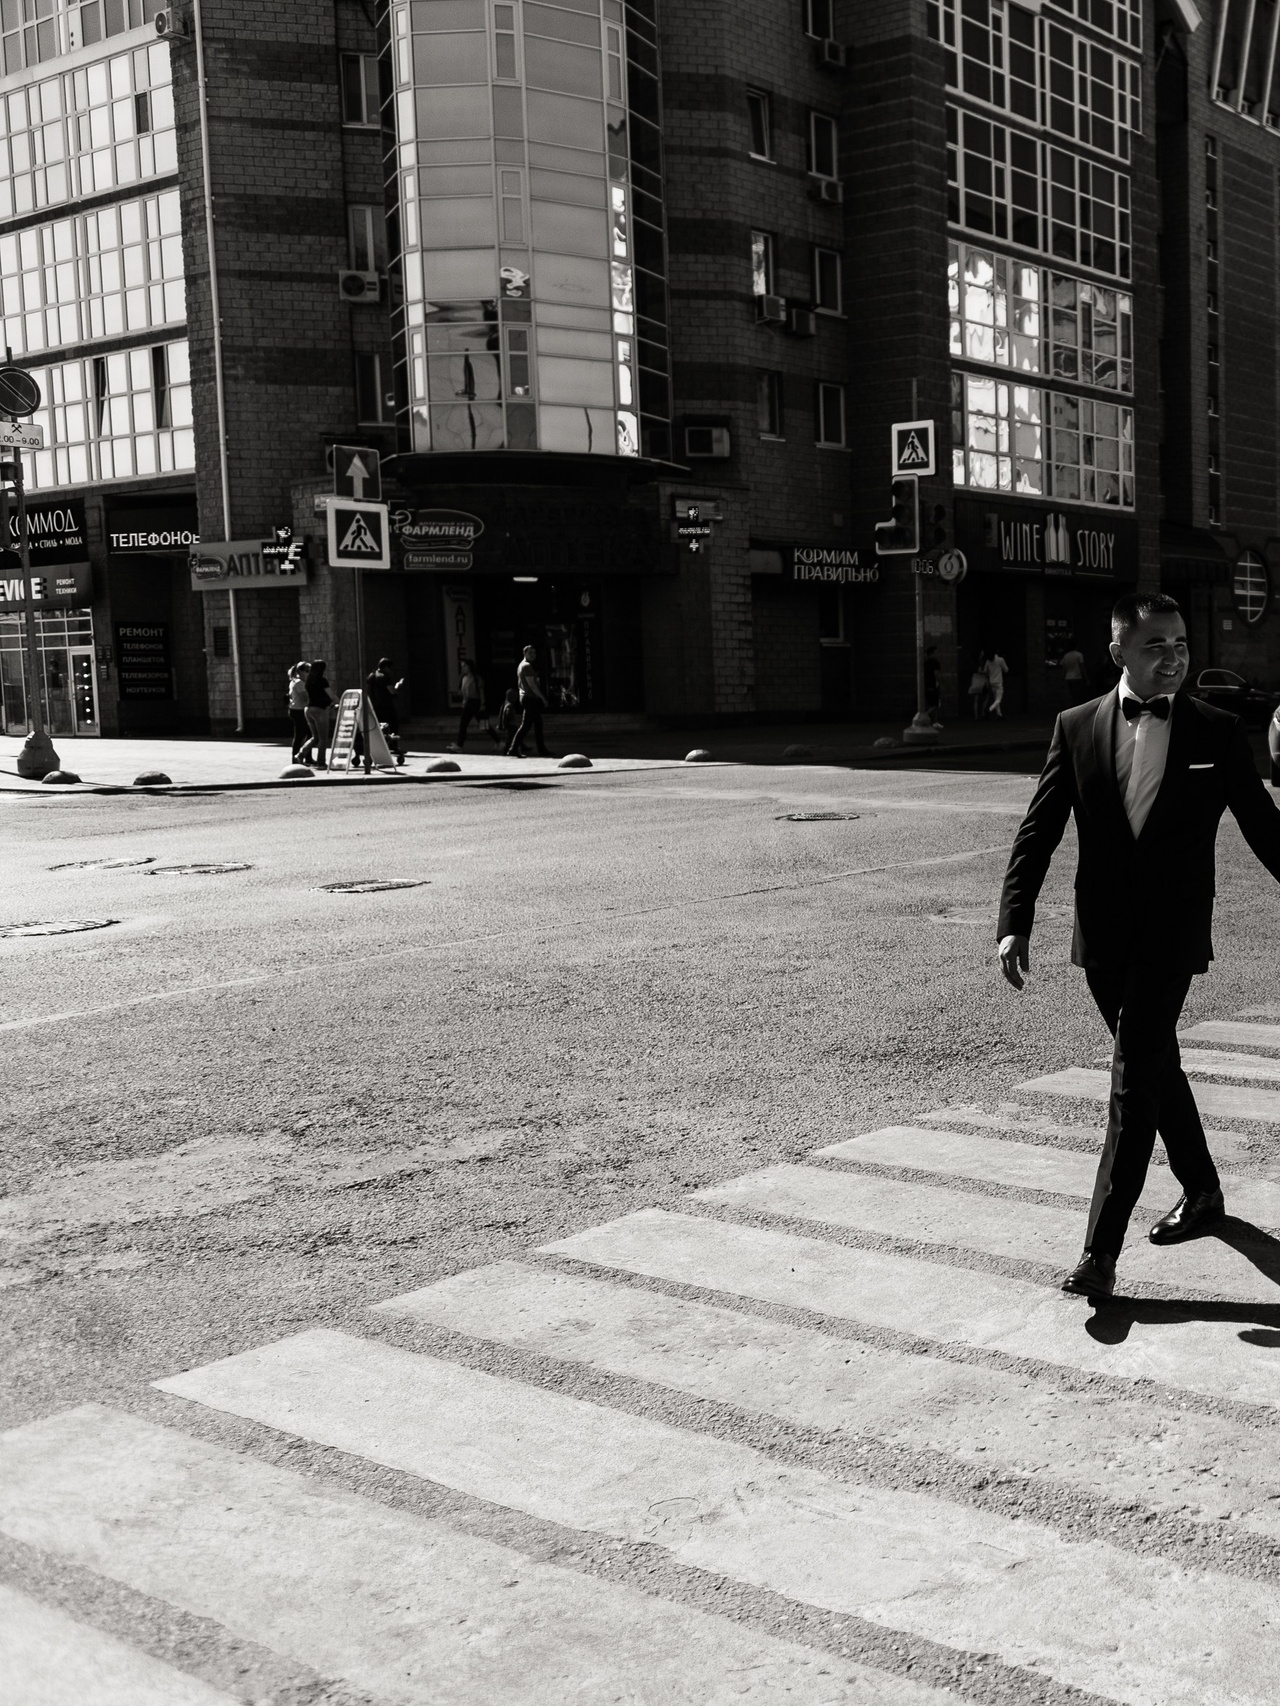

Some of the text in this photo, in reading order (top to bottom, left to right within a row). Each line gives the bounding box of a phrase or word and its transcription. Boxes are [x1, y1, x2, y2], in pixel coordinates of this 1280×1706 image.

[402, 525, 475, 537] ФАРМЛЕНД
[1001, 521, 1041, 562] WINE
[1077, 529, 1115, 570] STORY
[228, 553, 306, 576] АПТЕ
[408, 553, 468, 563] farmlend.ru
[794, 547, 859, 566] КОРМИМ
[119, 627, 165, 637] РЕМОНТ
